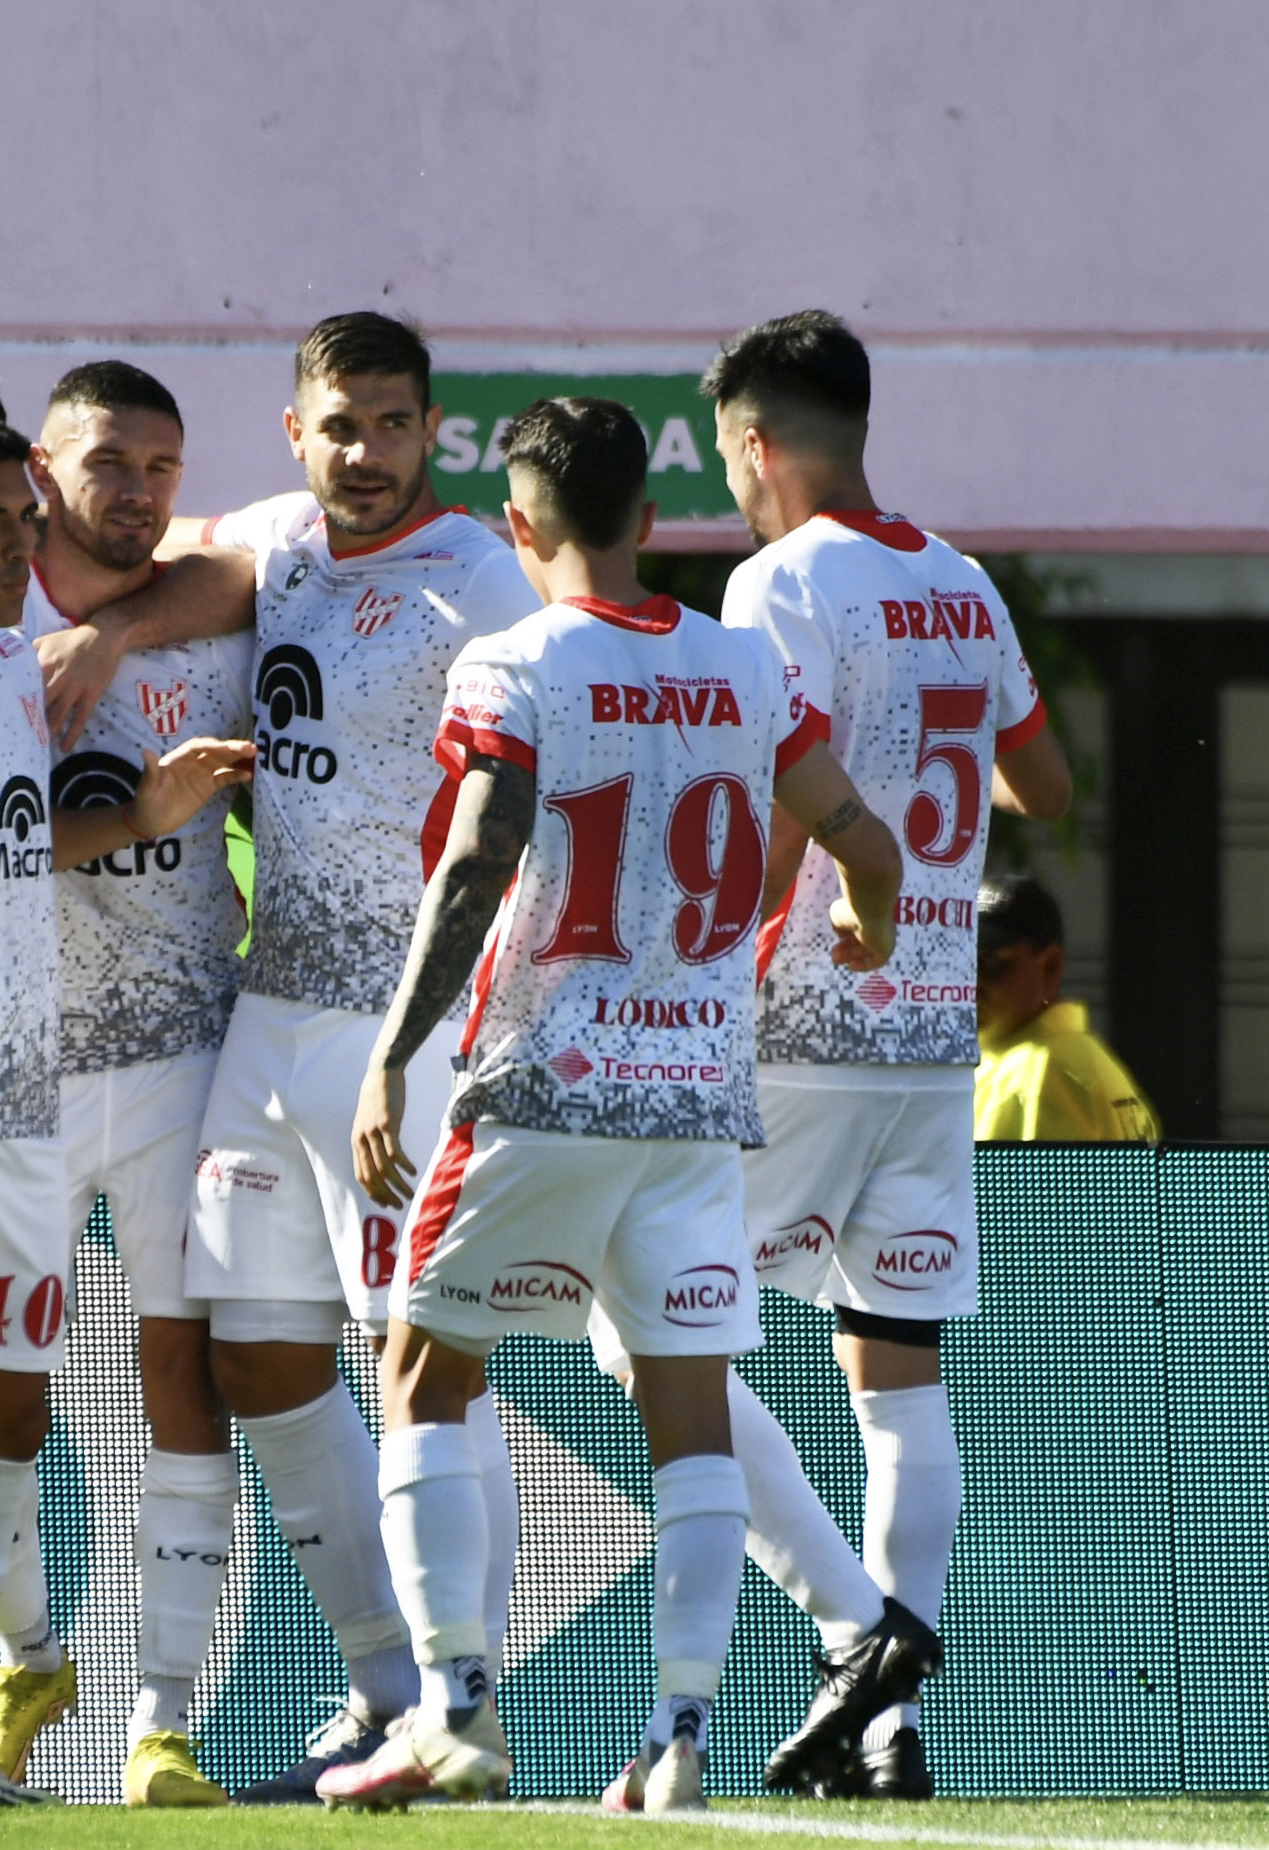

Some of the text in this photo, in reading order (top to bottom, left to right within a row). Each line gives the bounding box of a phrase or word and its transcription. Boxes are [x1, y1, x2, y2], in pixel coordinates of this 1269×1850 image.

[878, 599, 996, 641] BRAVA
[587, 683, 743, 727] BRAVA
[255, 729, 338, 785] acro
[904, 676, 989, 868] 5
[531, 771, 768, 966] 19
[362, 1215, 398, 1288] 8
[875, 1249, 952, 1273] MICAM
[440, 1284, 480, 1305] LYON
[490, 1278, 581, 1306] MICAM
[664, 1285, 737, 1312] MICAM
